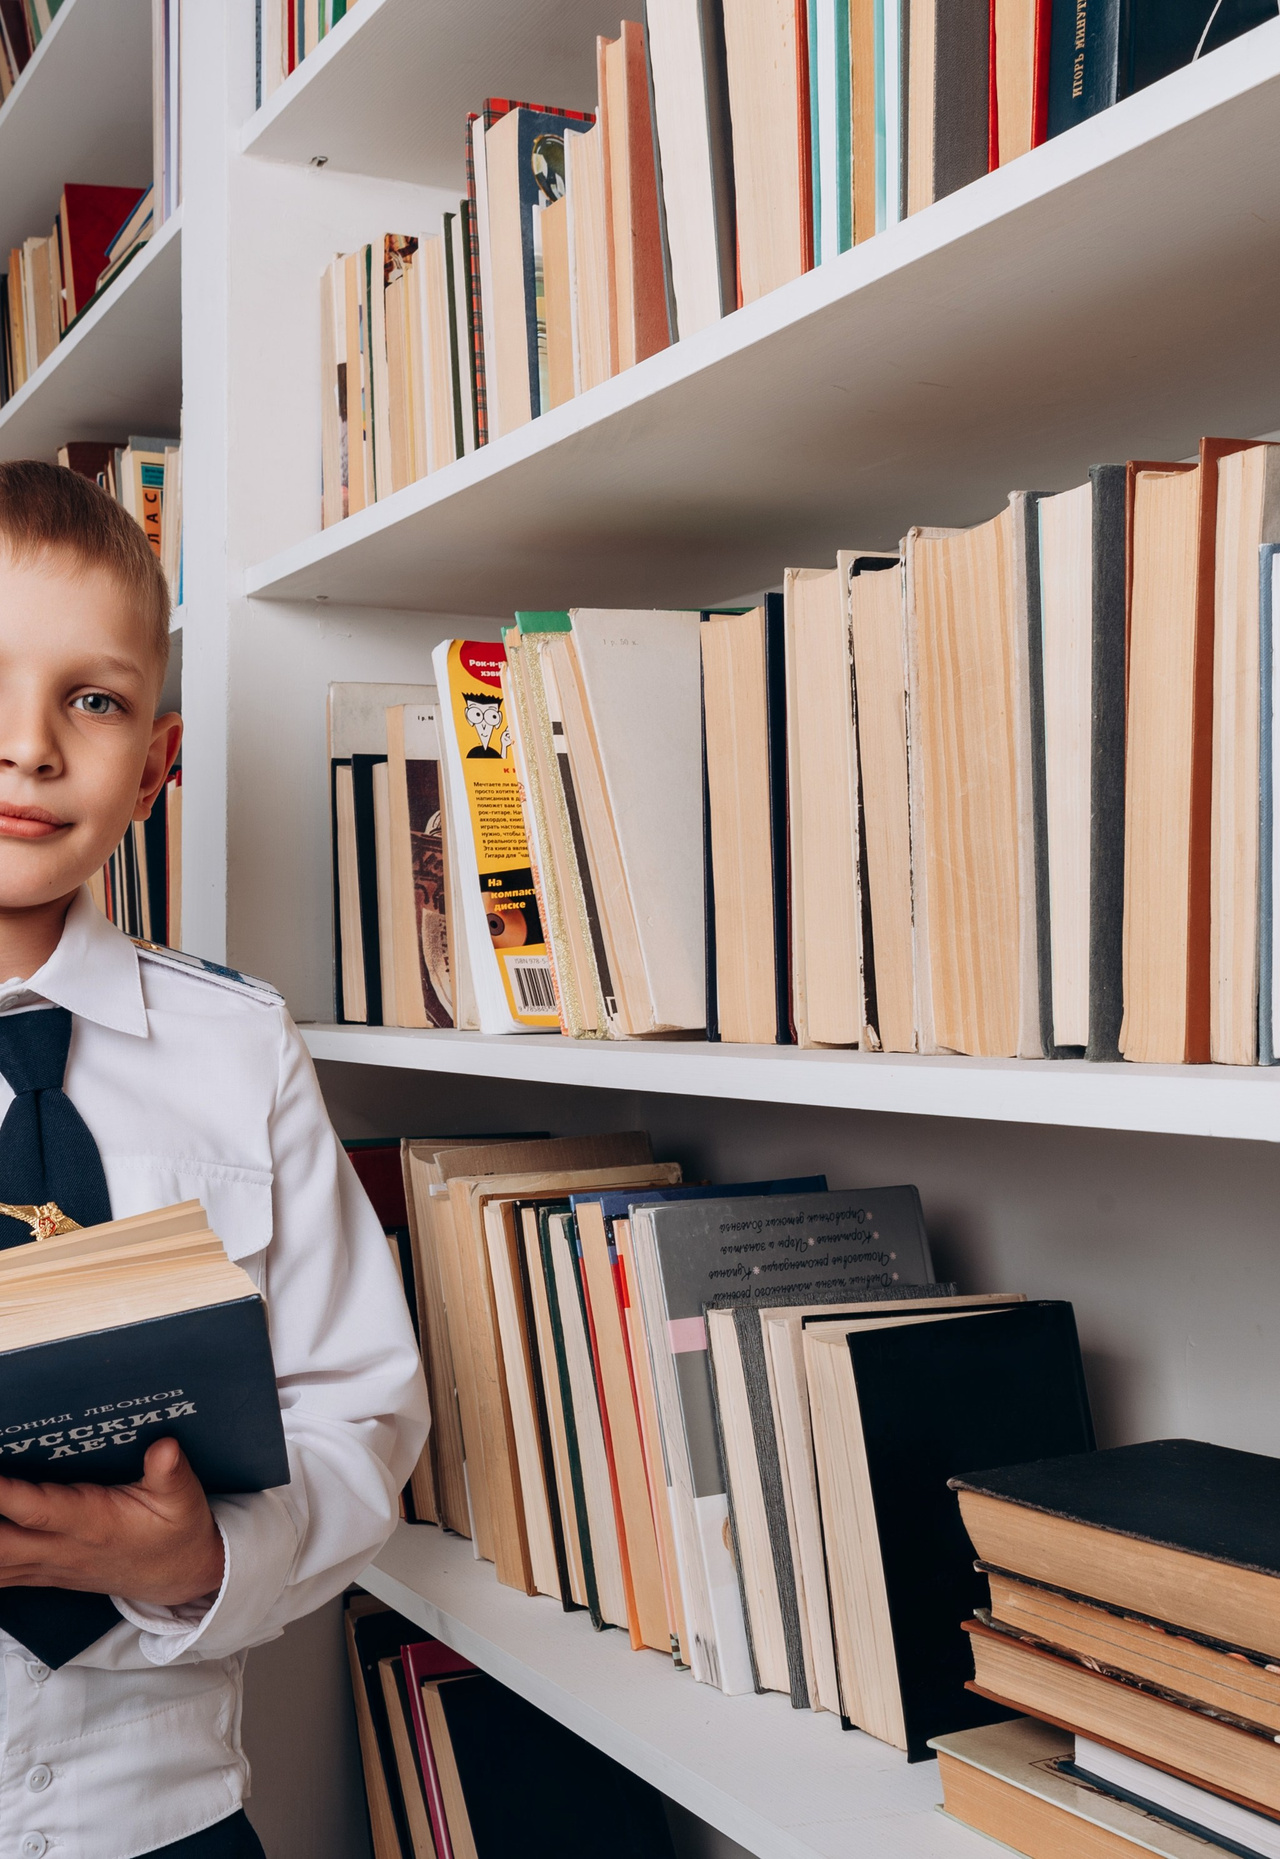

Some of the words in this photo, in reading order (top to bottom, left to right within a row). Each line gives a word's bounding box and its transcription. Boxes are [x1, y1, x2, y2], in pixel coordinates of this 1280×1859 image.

[1075, 0, 1087, 51] МИНУТ
[1072, 53, 1085, 99] ИГОРЬ
[488, 878, 503, 887] На
[494, 901, 526, 912] диске
[766, 1212, 804, 1226] детских
[807, 1207, 867, 1224] Справочник
[719, 1220, 763, 1234] болезней
[778, 1237, 808, 1253] Игры
[816, 1229, 871, 1245] Кормление
[720, 1242, 766, 1256] занятия
[761, 1253, 828, 1271] рекомендации
[832, 1252, 889, 1268] Пошаговые
[709, 1263, 752, 1281] Купание
[849, 1272, 892, 1288] Дневник
[755, 1282, 812, 1296] маленького
[815, 1278, 846, 1288] жизни
[83, 1388, 184, 1417] ЛЕОНОВ
[47, 1429, 139, 1460] ЛЕС
